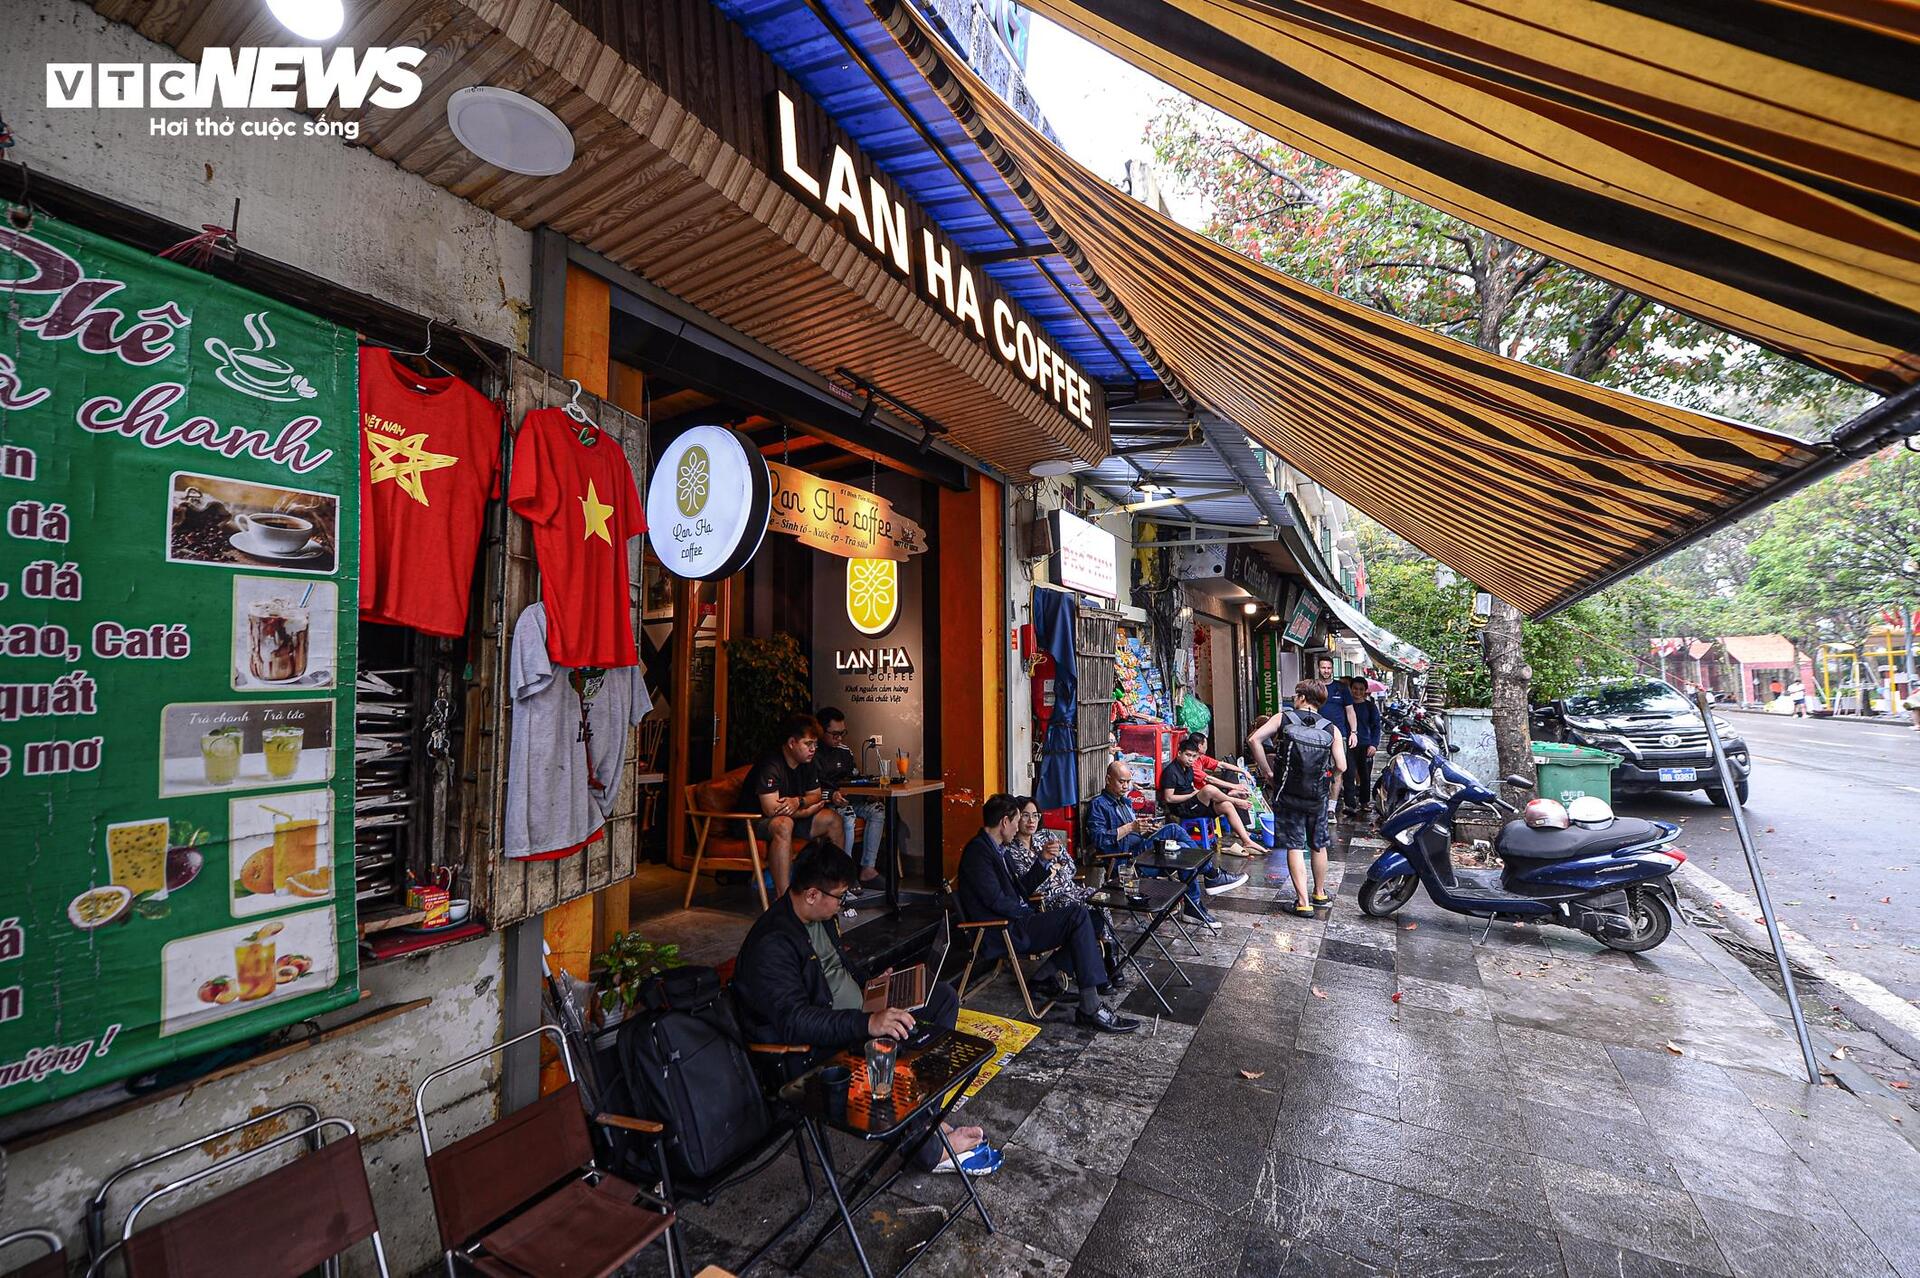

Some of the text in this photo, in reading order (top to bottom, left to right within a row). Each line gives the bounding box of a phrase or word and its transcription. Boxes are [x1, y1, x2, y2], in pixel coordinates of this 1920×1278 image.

[778, 90, 1093, 430] LAN HA COFFEE
[76, 382, 333, 474] chanh
[380, 420, 406, 437] NAM
[7, 501, 70, 543] đá
[781, 518, 799, 531] Sinh
[853, 506, 893, 545] coffee
[681, 542, 704, 563] coffee
[22, 560, 82, 602] đá
[0, 621, 190, 662] ao, Café
[836, 648, 910, 670] LAN HA
[868, 673, 913, 682] COFFEE
[1263, 671, 1273, 706] QUALITY
[189, 710, 250, 725] Trà chanh
[263, 708, 283, 721] Trà
[23, 737, 104, 776] mơ
